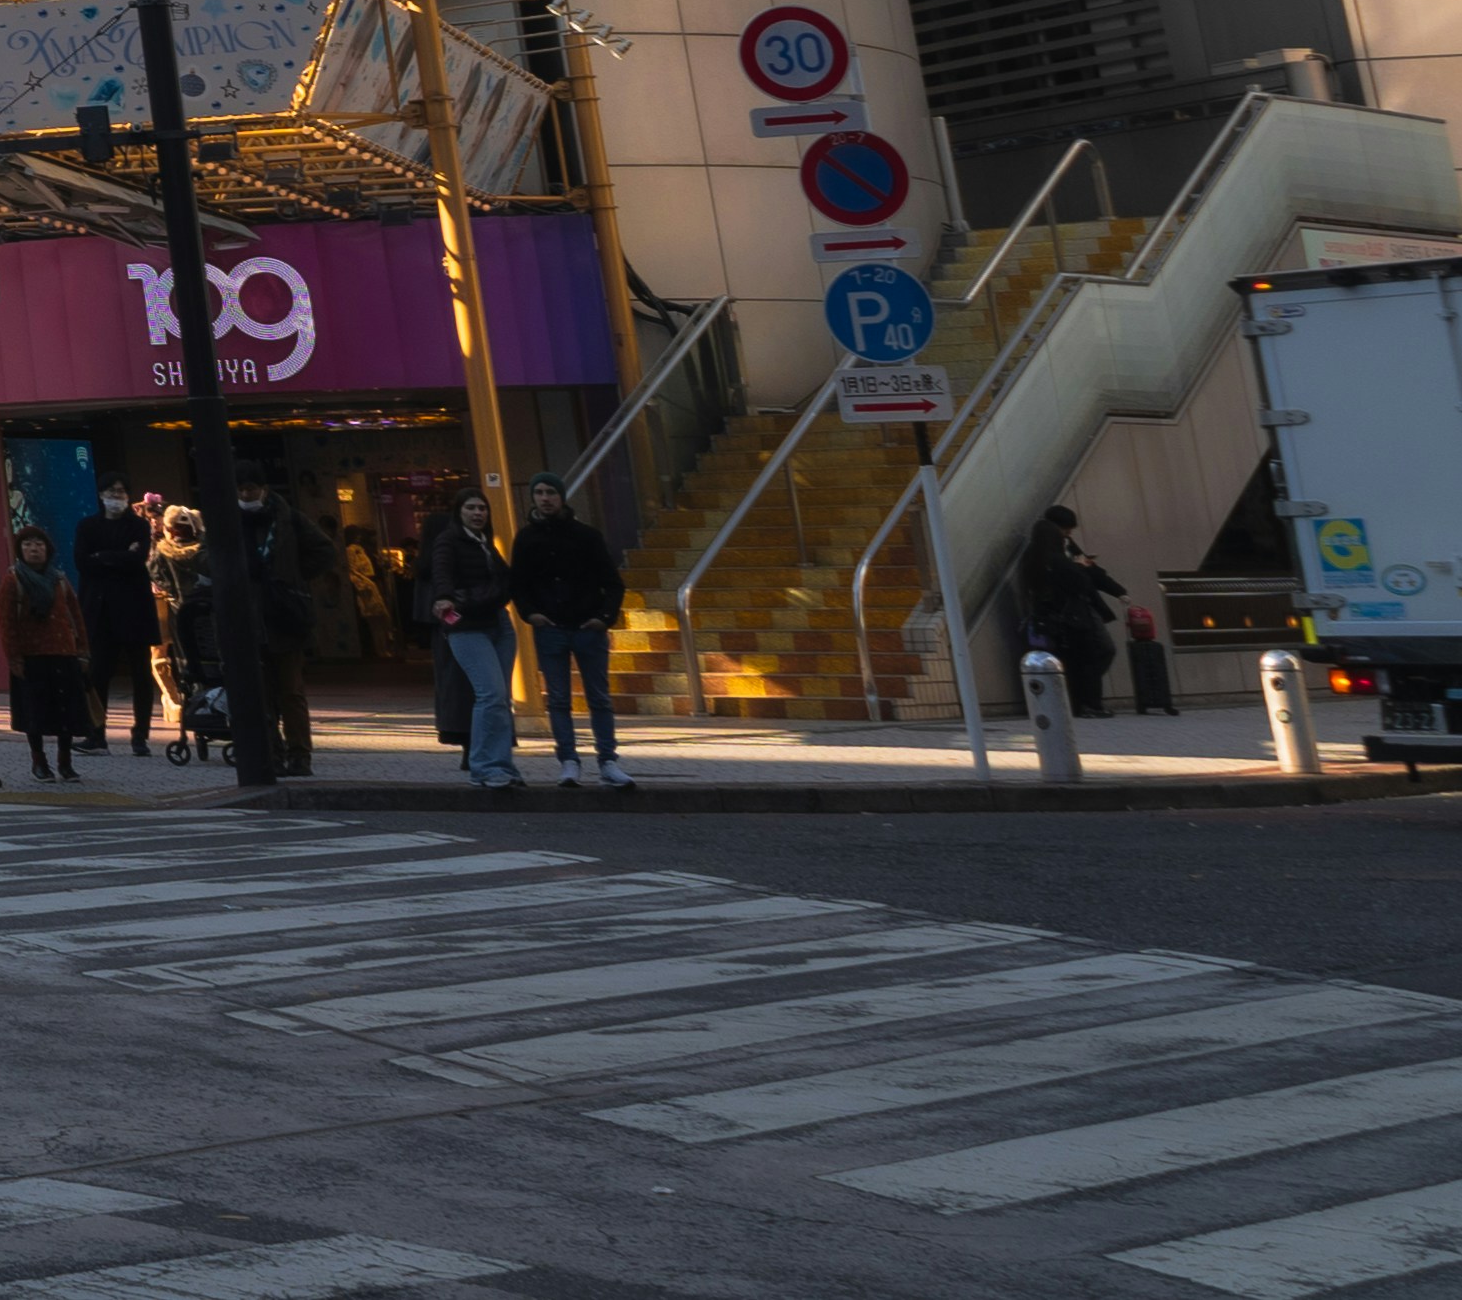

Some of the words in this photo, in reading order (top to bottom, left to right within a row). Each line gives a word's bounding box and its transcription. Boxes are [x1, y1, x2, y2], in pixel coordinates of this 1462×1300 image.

[6, 26, 117, 78] XMAS
[763, 31, 826, 77] 30
[828, 131, 867, 146] 20-7
[849, 264, 897, 285] 7-20
[125, 256, 317, 382] 109
[847, 290, 891, 352] P
[882, 323, 913, 350] 40
